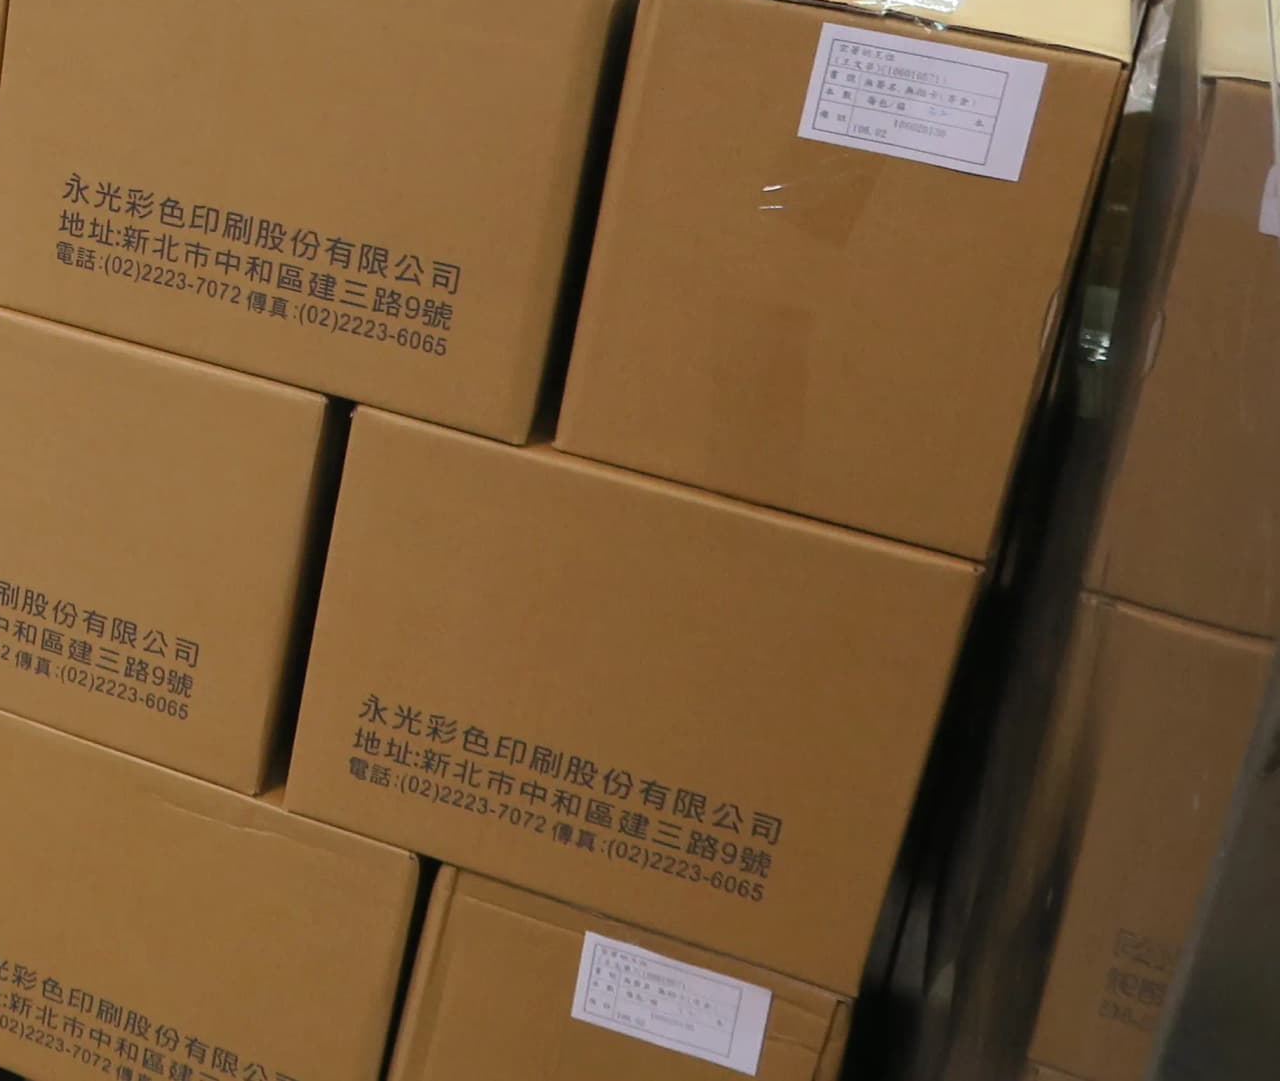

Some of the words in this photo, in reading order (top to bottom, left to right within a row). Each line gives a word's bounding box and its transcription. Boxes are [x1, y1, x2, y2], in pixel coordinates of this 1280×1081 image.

[61, 172, 462, 295] 永光彩色印刷股份有限公司
[357, 693, 783, 846] 永光彩色印刷股份有限公司
